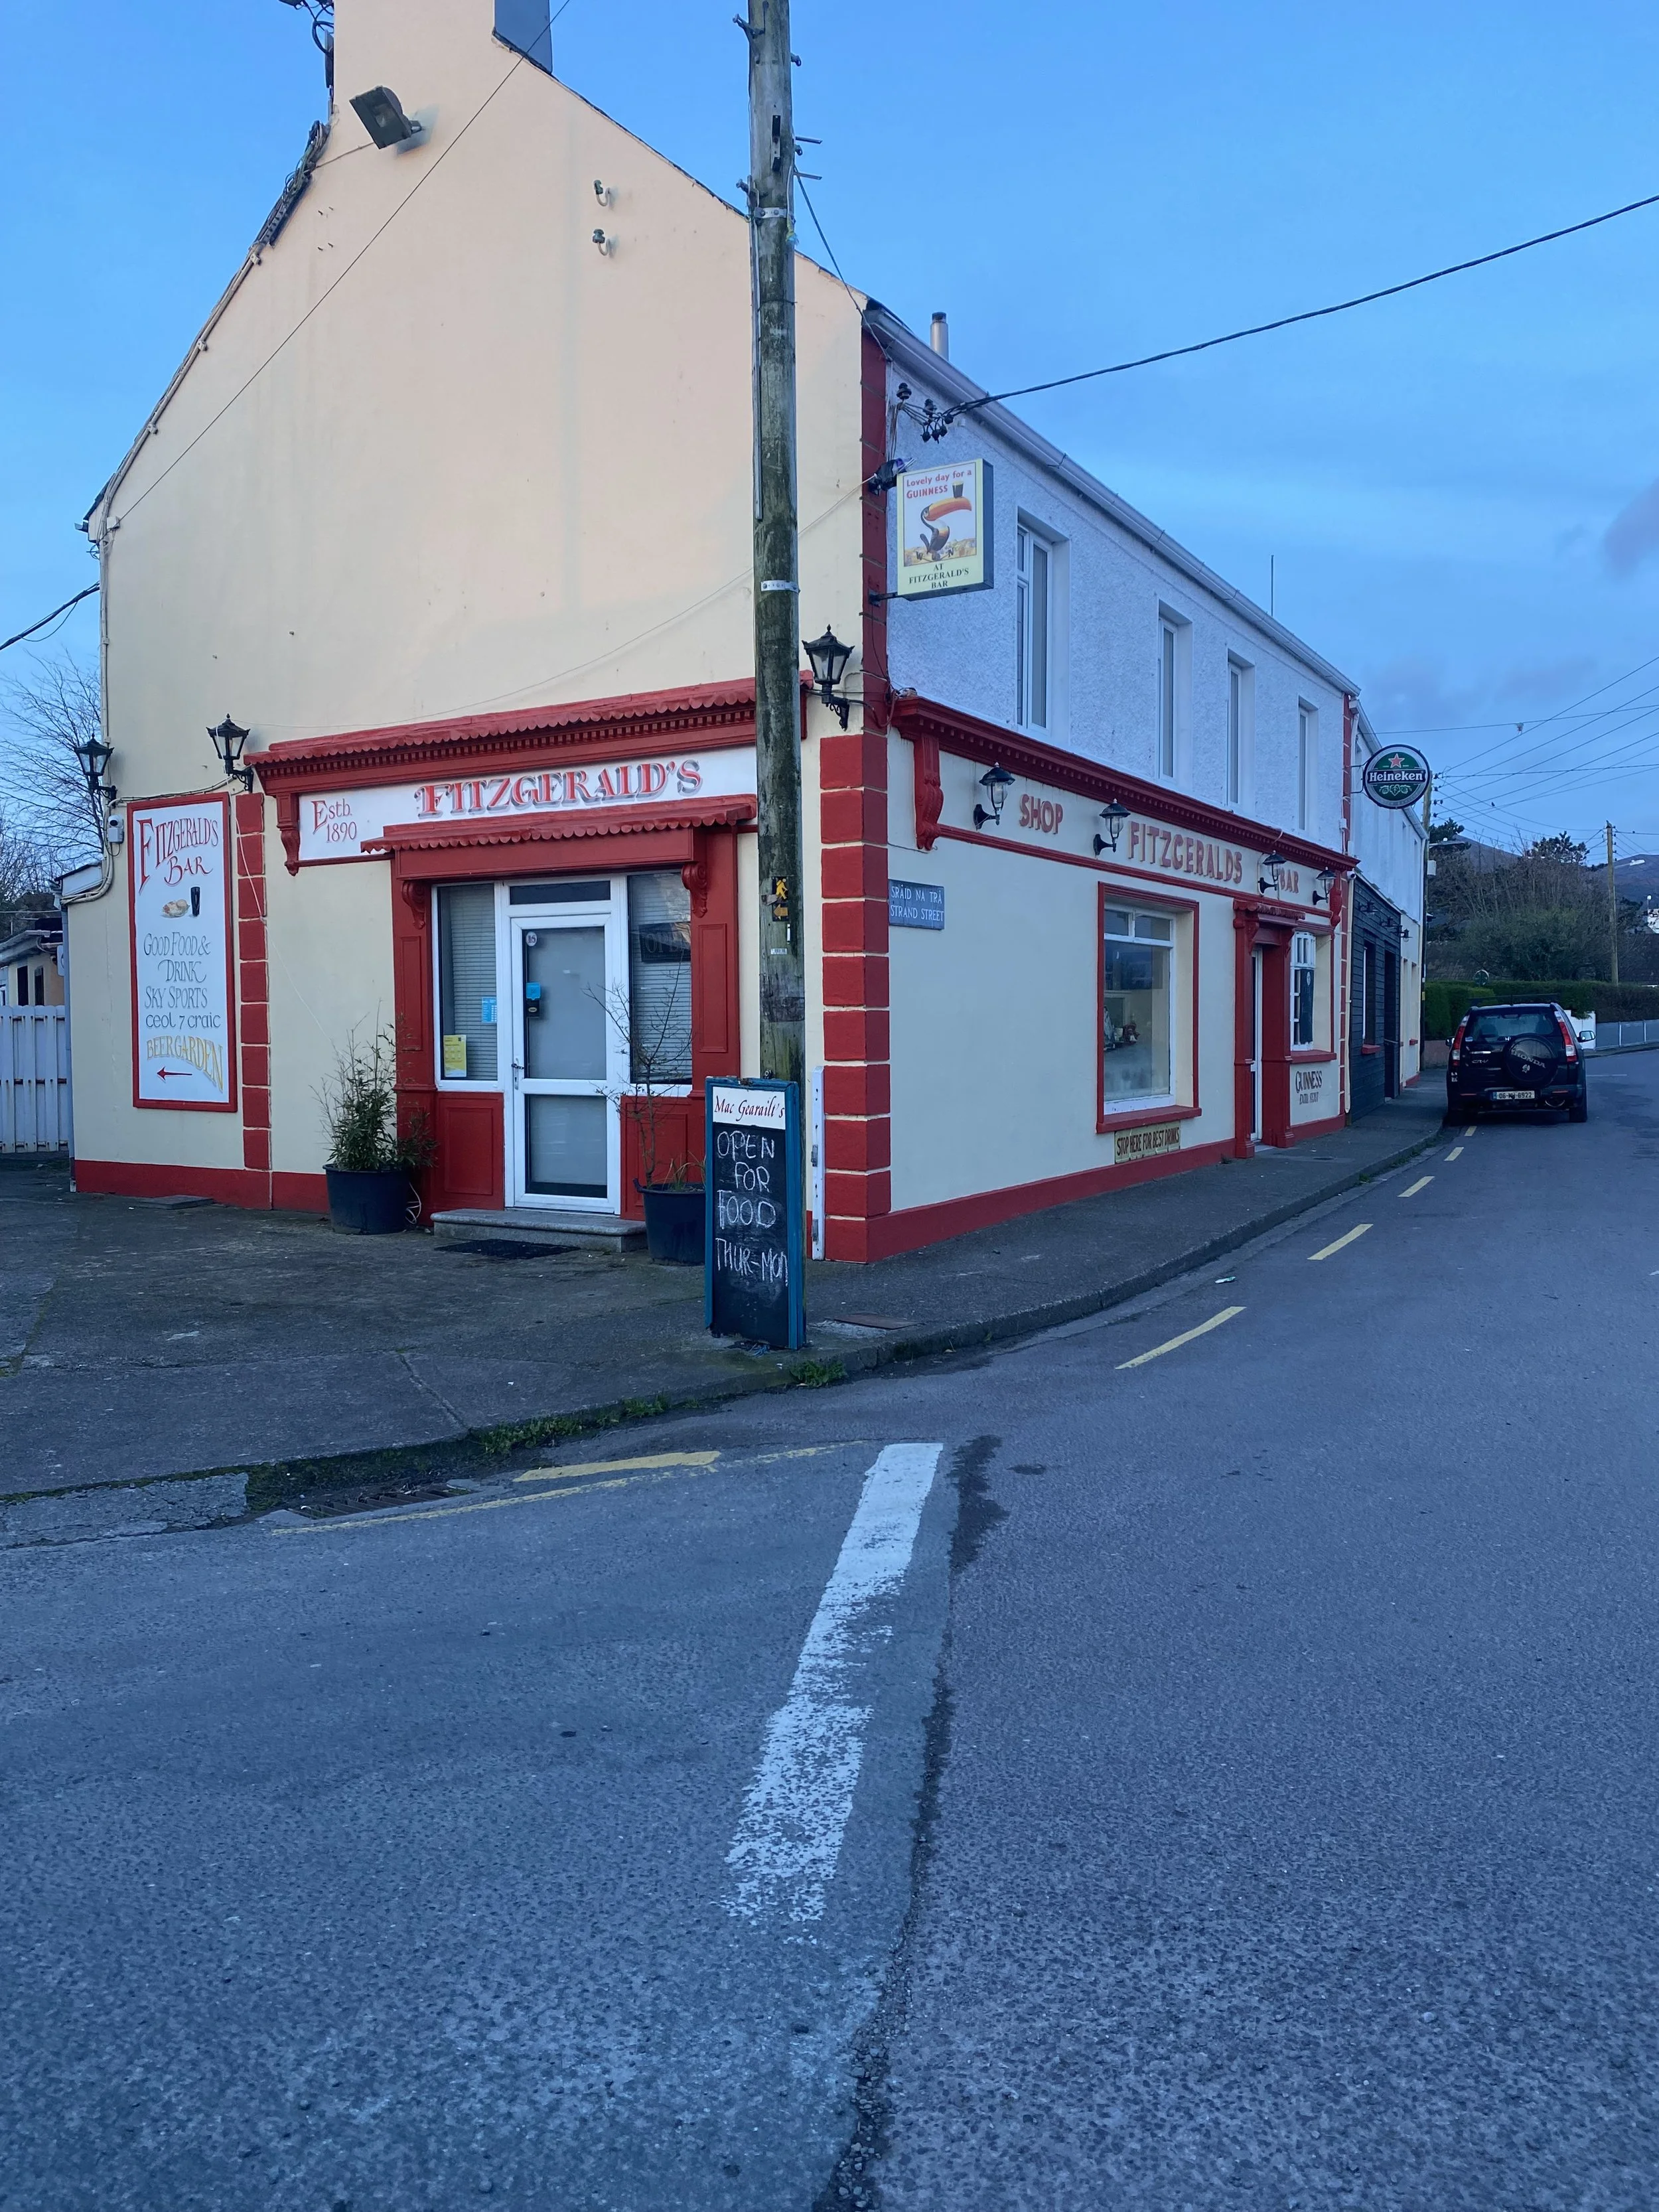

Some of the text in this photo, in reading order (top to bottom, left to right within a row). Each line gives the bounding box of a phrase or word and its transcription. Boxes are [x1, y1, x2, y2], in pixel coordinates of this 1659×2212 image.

[906, 475, 932, 487] Lovely
[936, 473, 950, 482] day
[952, 470, 964, 479] for
[906, 484, 948, 499] GUINNESS
[909, 567, 969, 584] FITZGERALD'S
[414, 759, 701, 819] FITZGERALD'S
[1369, 771, 1423, 782] Heineken
[311, 798, 352, 835] Estb.
[1019, 794, 1063, 835] SHOP
[326, 821, 357, 844] 1890
[136, 818, 219, 894] FITZGERALD'S
[164, 855, 214, 886] BAR
[1279, 867, 1299, 894] BAR
[916, 889, 925, 902] NA
[891, 905, 944, 922] STRAND STREET
[143, 931, 211, 956] GOOD FOOD &
[157, 959, 207, 984] DRINK
[145, 985, 208, 1009] SKY SPORTS
[145, 1011, 176, 1028] ceol
[187, 1011, 221, 1029] craic
[147, 1035, 224, 1094] BEER GARDEN
[1512, 1049, 1546, 1069] HONDA
[714, 1095, 785, 1122] Mac Gearailt's
[717, 1130, 775, 1161] OPEN
[1117, 1136, 1129, 1156] STOP
[1129, 1134, 1141, 1153] HERE
[1142, 1132, 1152, 1150] FOR
[1152, 1130, 1164, 1149] BEST
[735, 1161, 770, 1193] FOR
[717, 1189, 776, 1230] FOOD
